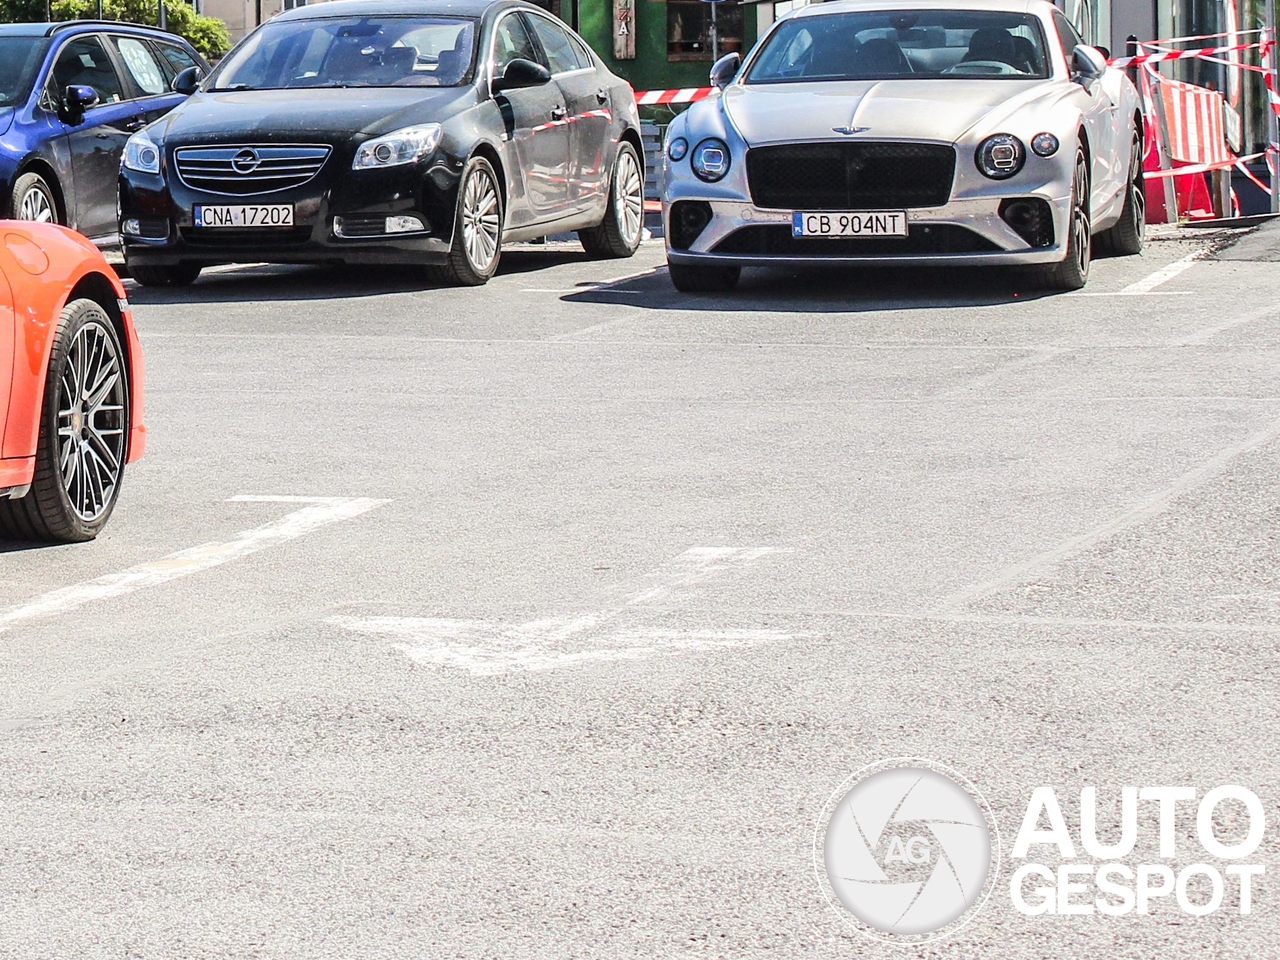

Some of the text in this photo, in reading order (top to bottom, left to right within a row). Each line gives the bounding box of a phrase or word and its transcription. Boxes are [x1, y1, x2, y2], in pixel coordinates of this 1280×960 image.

[203, 207, 291, 225] CNA 17202
[807, 215, 899, 233] CB 904NT
